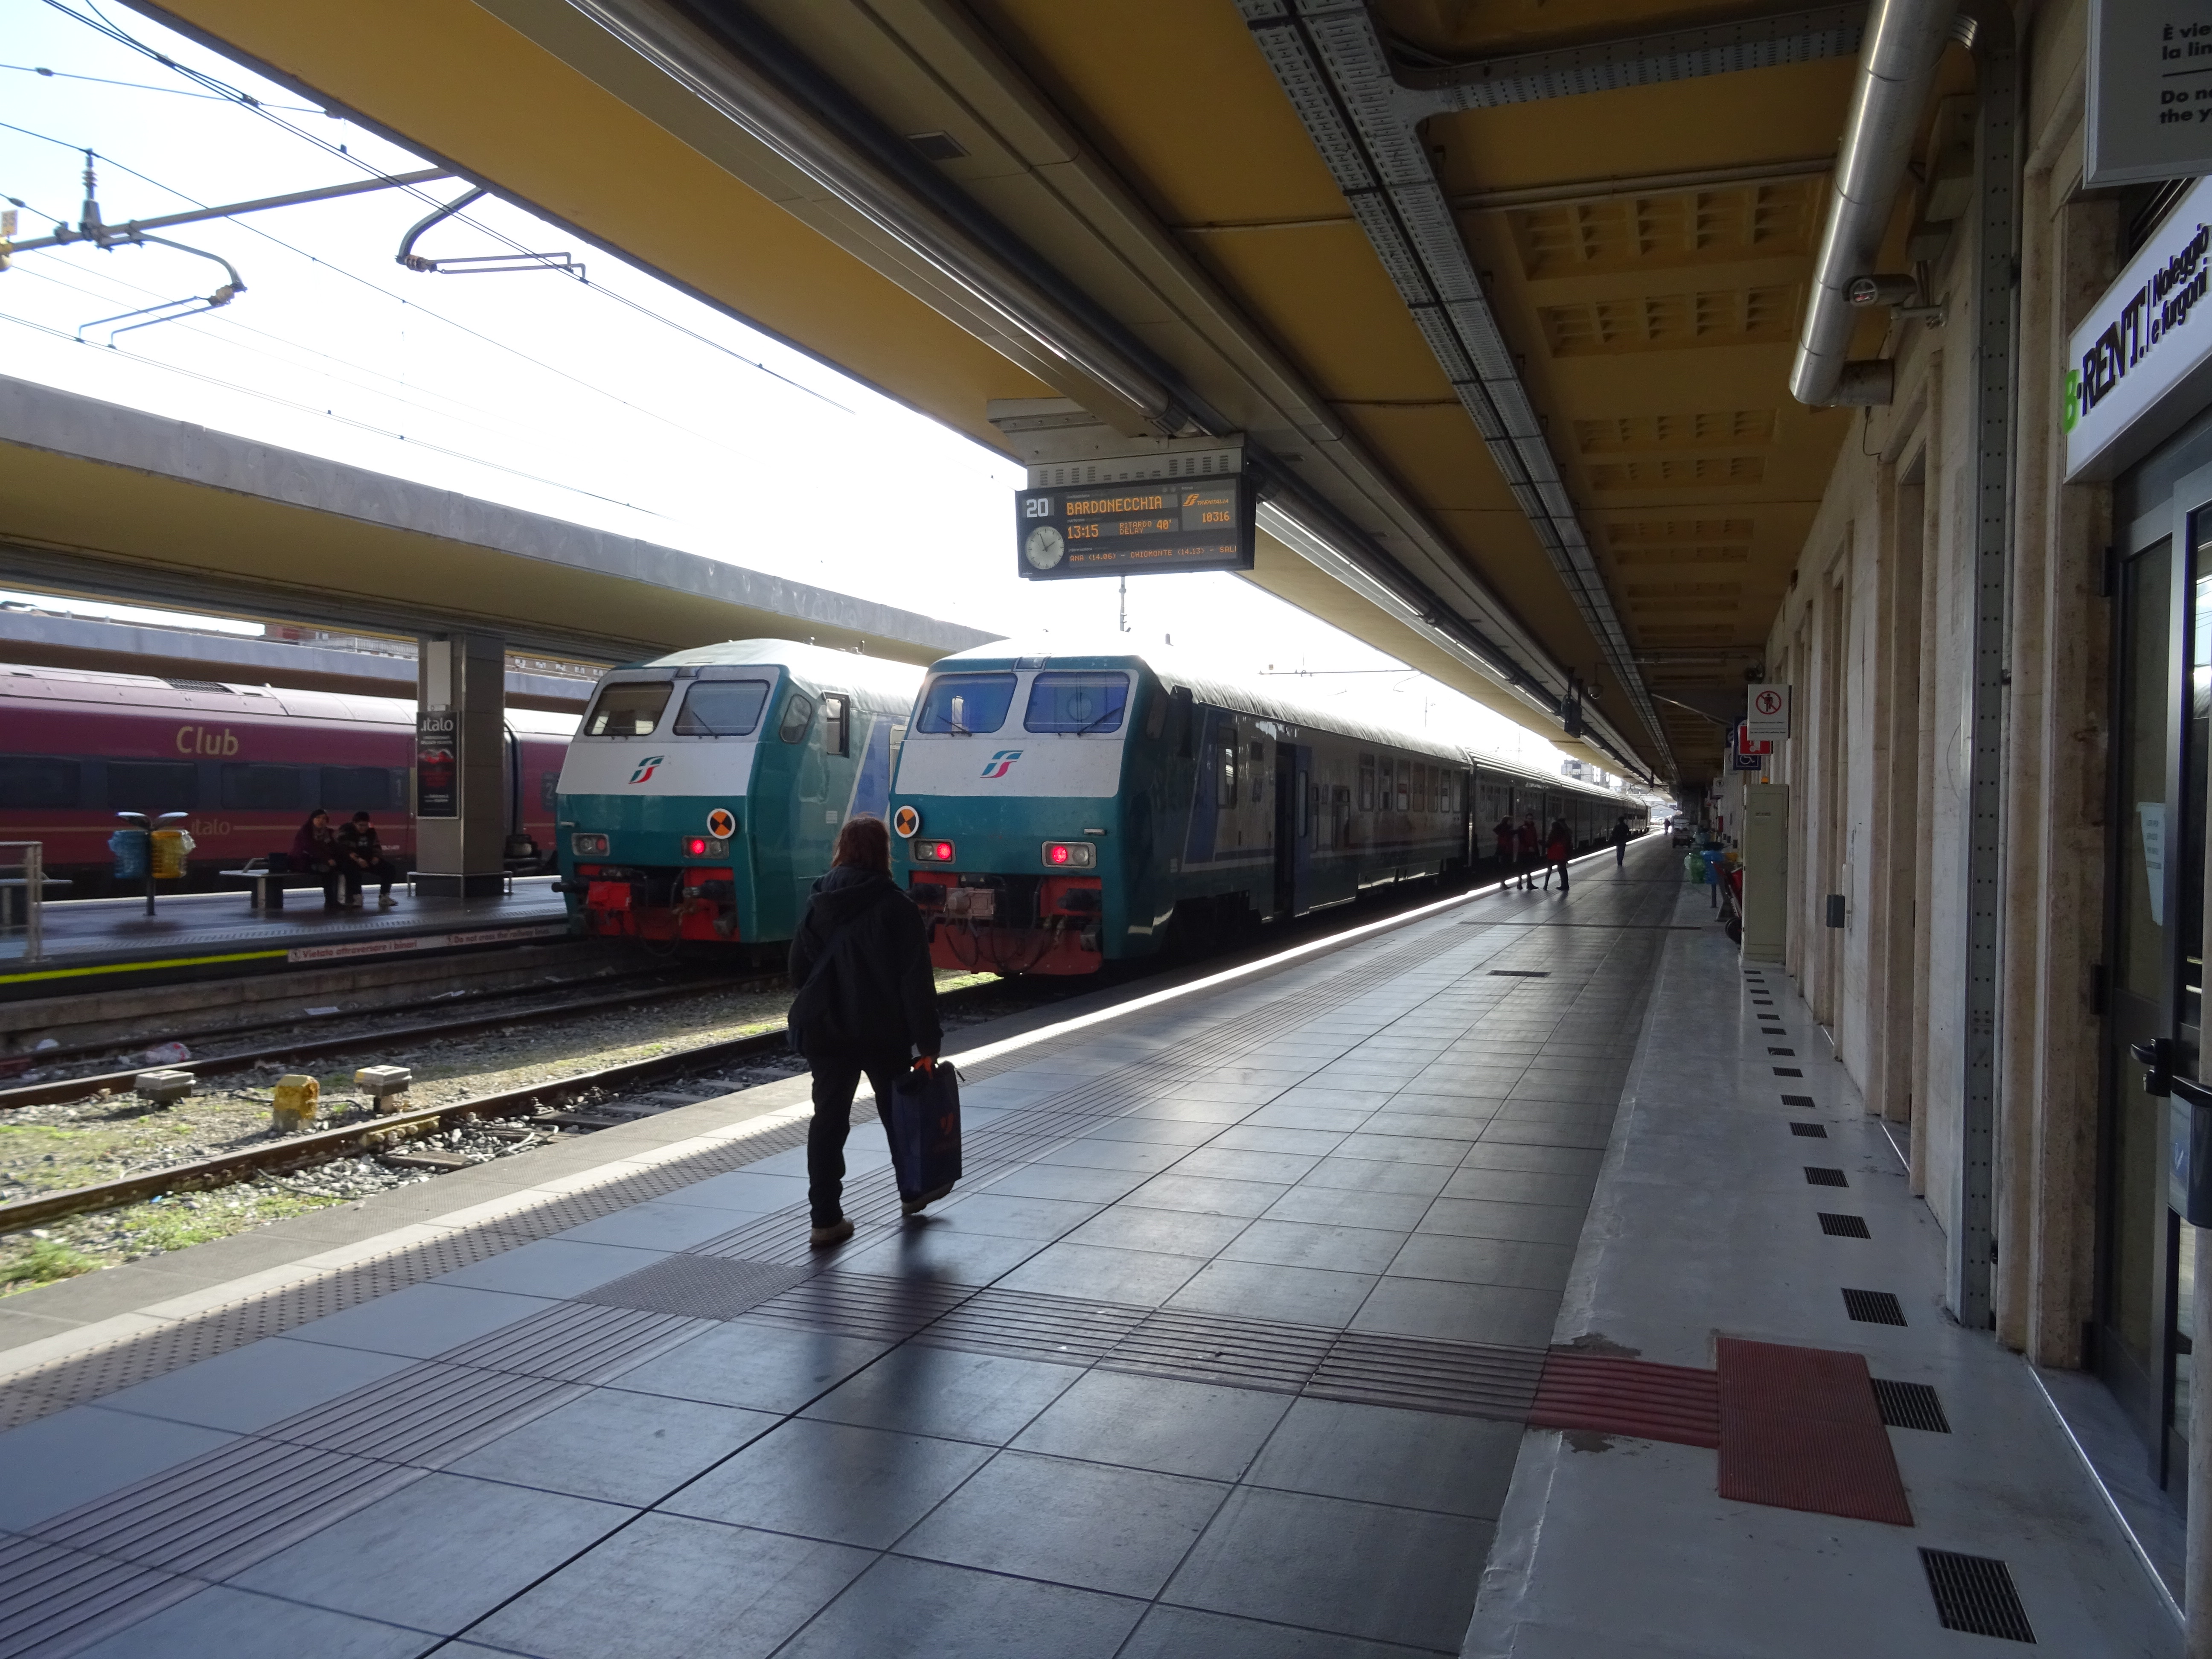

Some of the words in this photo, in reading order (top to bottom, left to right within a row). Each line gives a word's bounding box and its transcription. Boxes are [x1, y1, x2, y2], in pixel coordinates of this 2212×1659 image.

[2163, 23, 2173, 41] È
[2162, 45, 2181, 60] la
[2161, 90, 2189, 104] Do
[2160, 109, 2193, 123] the
[2153, 223, 2208, 307] Noleggio
[2151, 319, 2159, 344] e
[2162, 257, 2208, 335] furgoni
[1026, 498, 1048, 518] 20
[1066, 495, 1162, 516] BARDONECCHIA
[1202, 511, 1230, 523] 10316
[1068, 524, 1099, 539] 13:15
[1120, 521, 1152, 529] RITARDO
[1089, 553, 1117, 561] (14.06)
[1130, 549, 1173, 558] CHIOMONTE
[1177, 547, 1204, 556] (14.13)
[176, 726, 239, 756] Club
[454, 935, 464, 943] Do
[303, 949, 333, 958] Vietato
[336, 944, 387, 955] attraversare
[394, 939, 417, 949] binari
